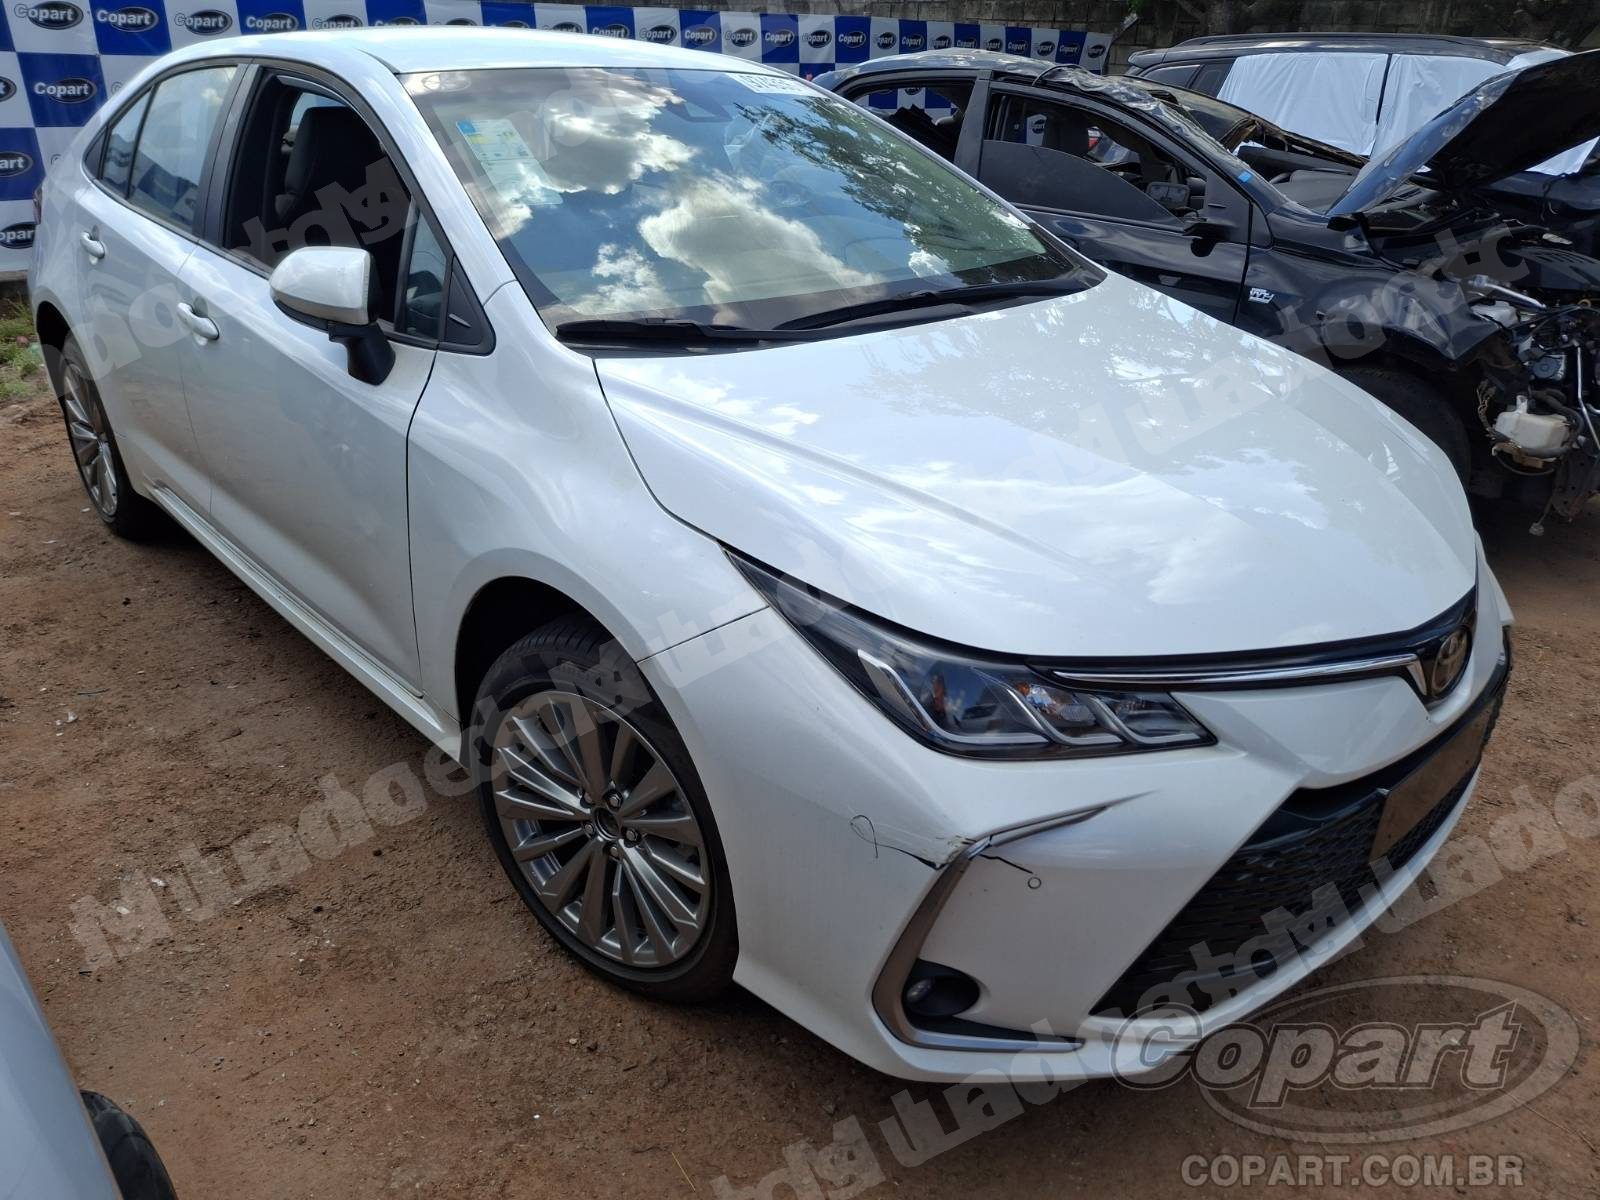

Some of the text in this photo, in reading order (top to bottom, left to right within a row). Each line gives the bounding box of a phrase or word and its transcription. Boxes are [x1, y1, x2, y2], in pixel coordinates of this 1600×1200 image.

[14, 4, 73, 21] Copart
[97, 9, 151, 26] Copart
[174, 13, 225, 29] Copart
[245, 16, 292, 31] Copart
[639, 28, 672, 40] Copart
[685, 29, 713, 42] Copart
[725, 29, 753, 42] Copart
[765, 32, 791, 43] Copart
[838, 33, 863, 44] Copart
[34, 82, 89, 98] Copart
[0, 156, 24, 169] art
[0, 230, 34, 243] opar
